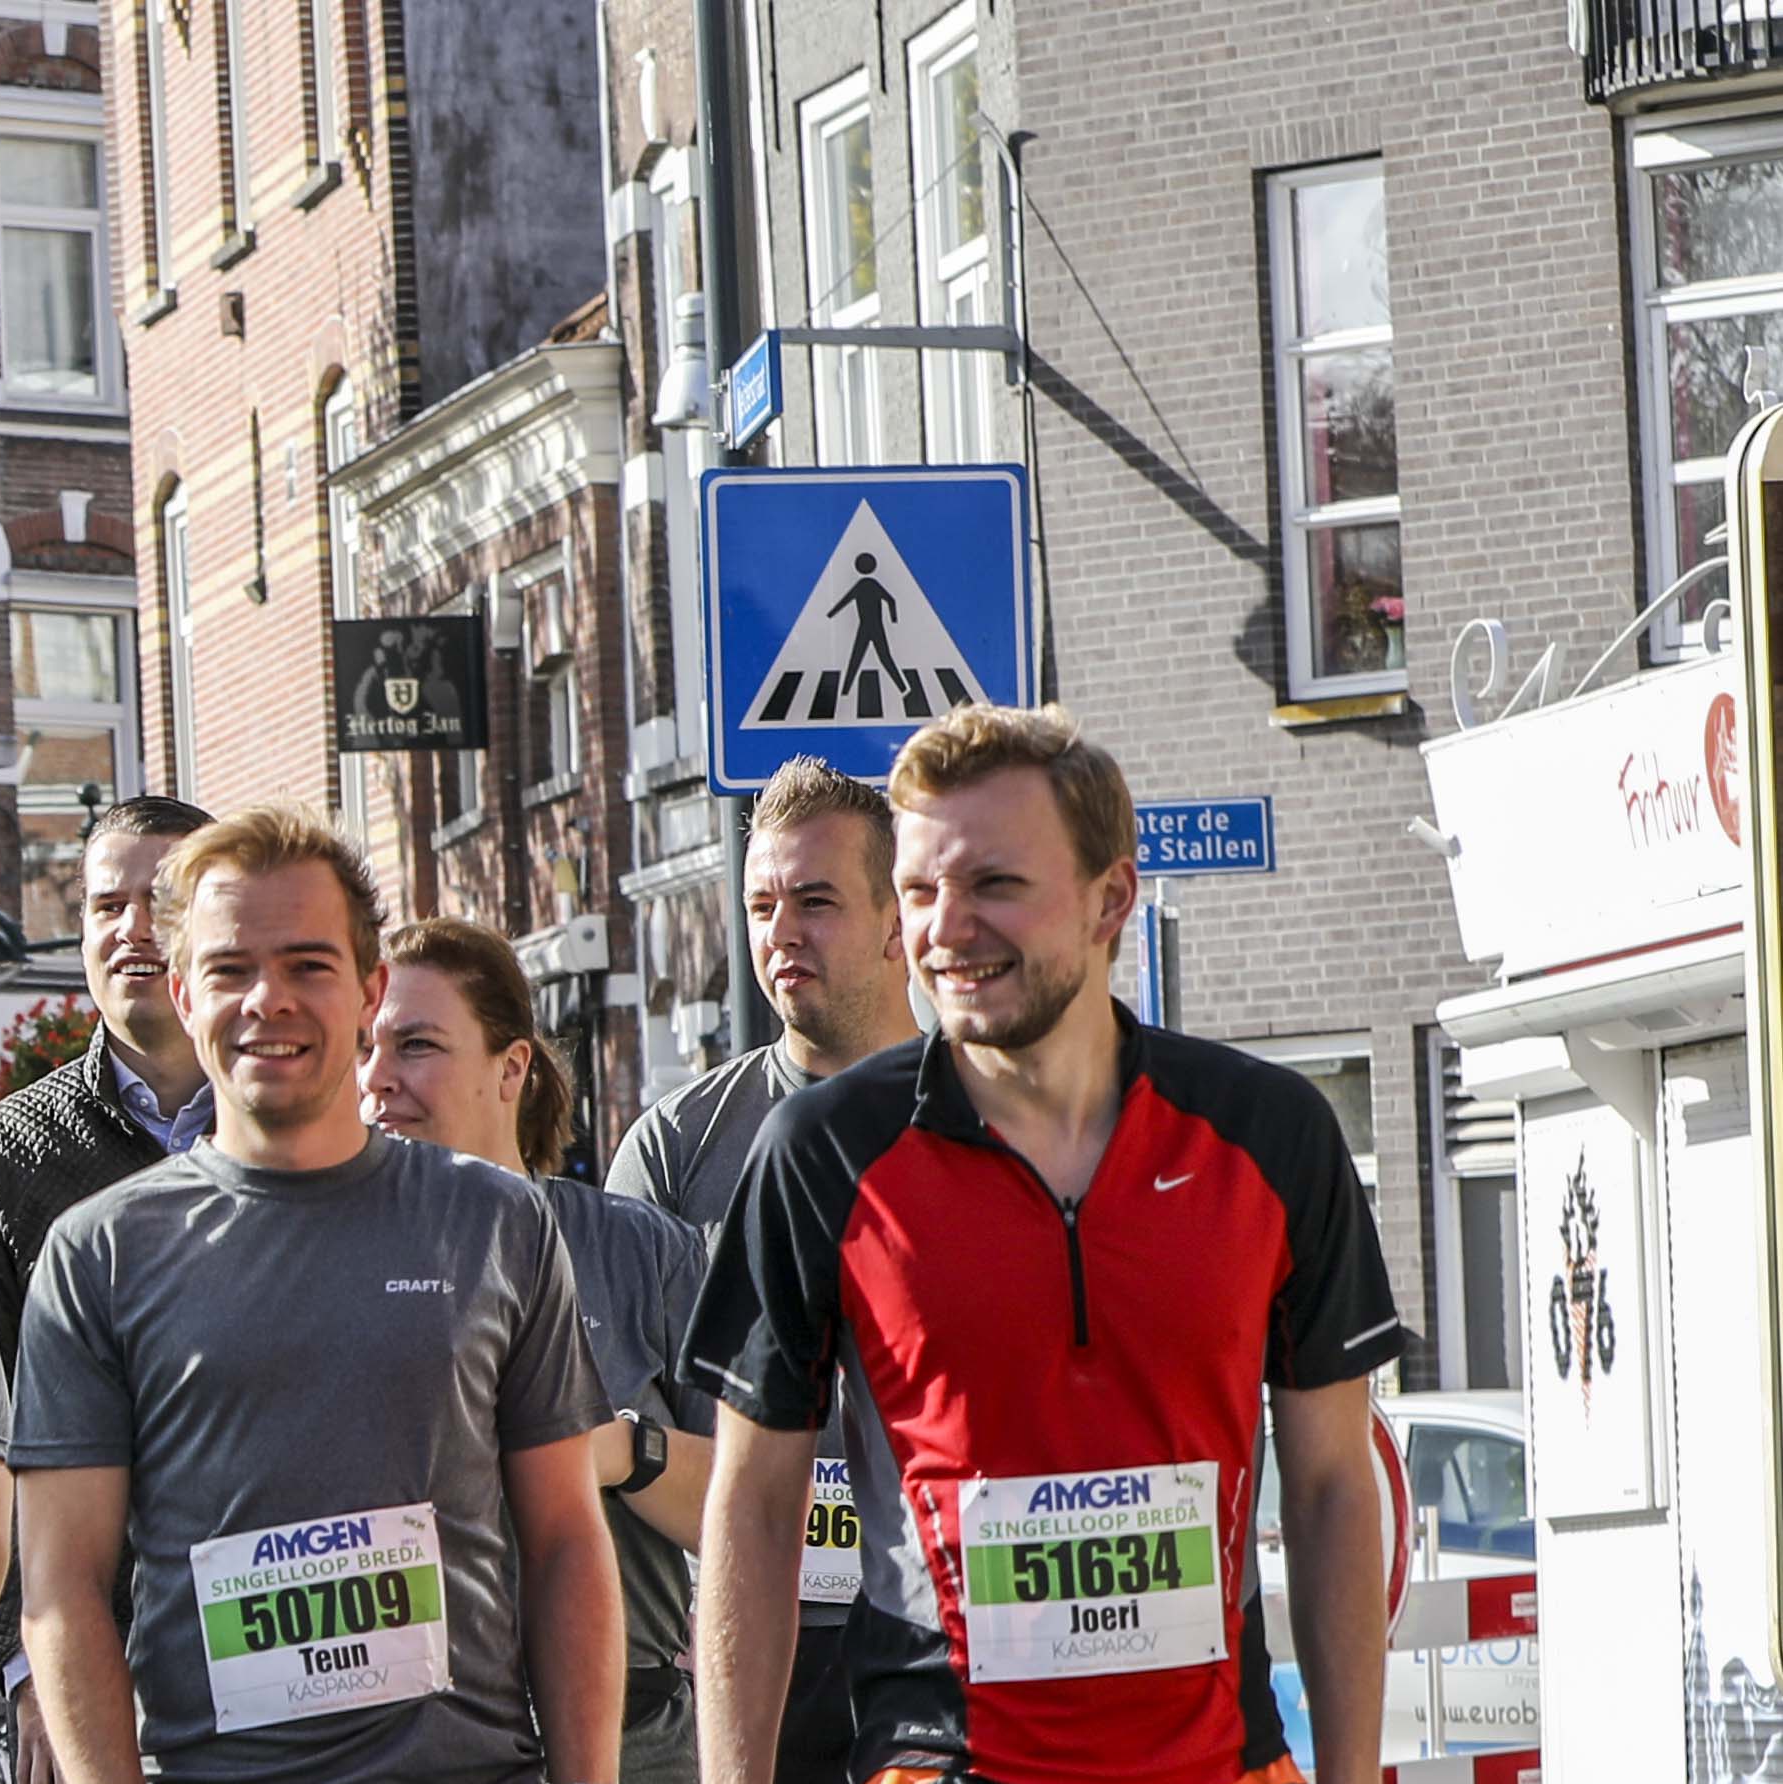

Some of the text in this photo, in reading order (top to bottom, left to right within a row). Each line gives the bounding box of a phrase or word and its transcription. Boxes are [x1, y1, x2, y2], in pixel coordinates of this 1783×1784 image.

[344, 711, 461, 737] Hertog Jan
[1618, 751, 1700, 850] Frituur
[1197, 808, 1230, 831] de
[1160, 835, 1257, 862] Stallen
[385, 1280, 440, 1293] CRAFT
[1028, 1473, 1151, 1514] AMGEN
[806, 1503, 858, 1548] 96
[979, 1506, 1200, 1539] SINGELLOOP BREDA
[252, 1517, 372, 1566] AMGEN
[212, 1546, 425, 1597] SINGELLOOP BREDA
[804, 1574, 861, 1590] KASPAR
[1012, 1531, 1182, 1602] 51634
[240, 1570, 411, 1650] 50709
[1070, 1599, 1139, 1634] Joeri
[298, 1643, 369, 1676] Teun
[1052, 1633, 1157, 1660] KASPAROV
[287, 1668, 389, 1702] KASPAROV
